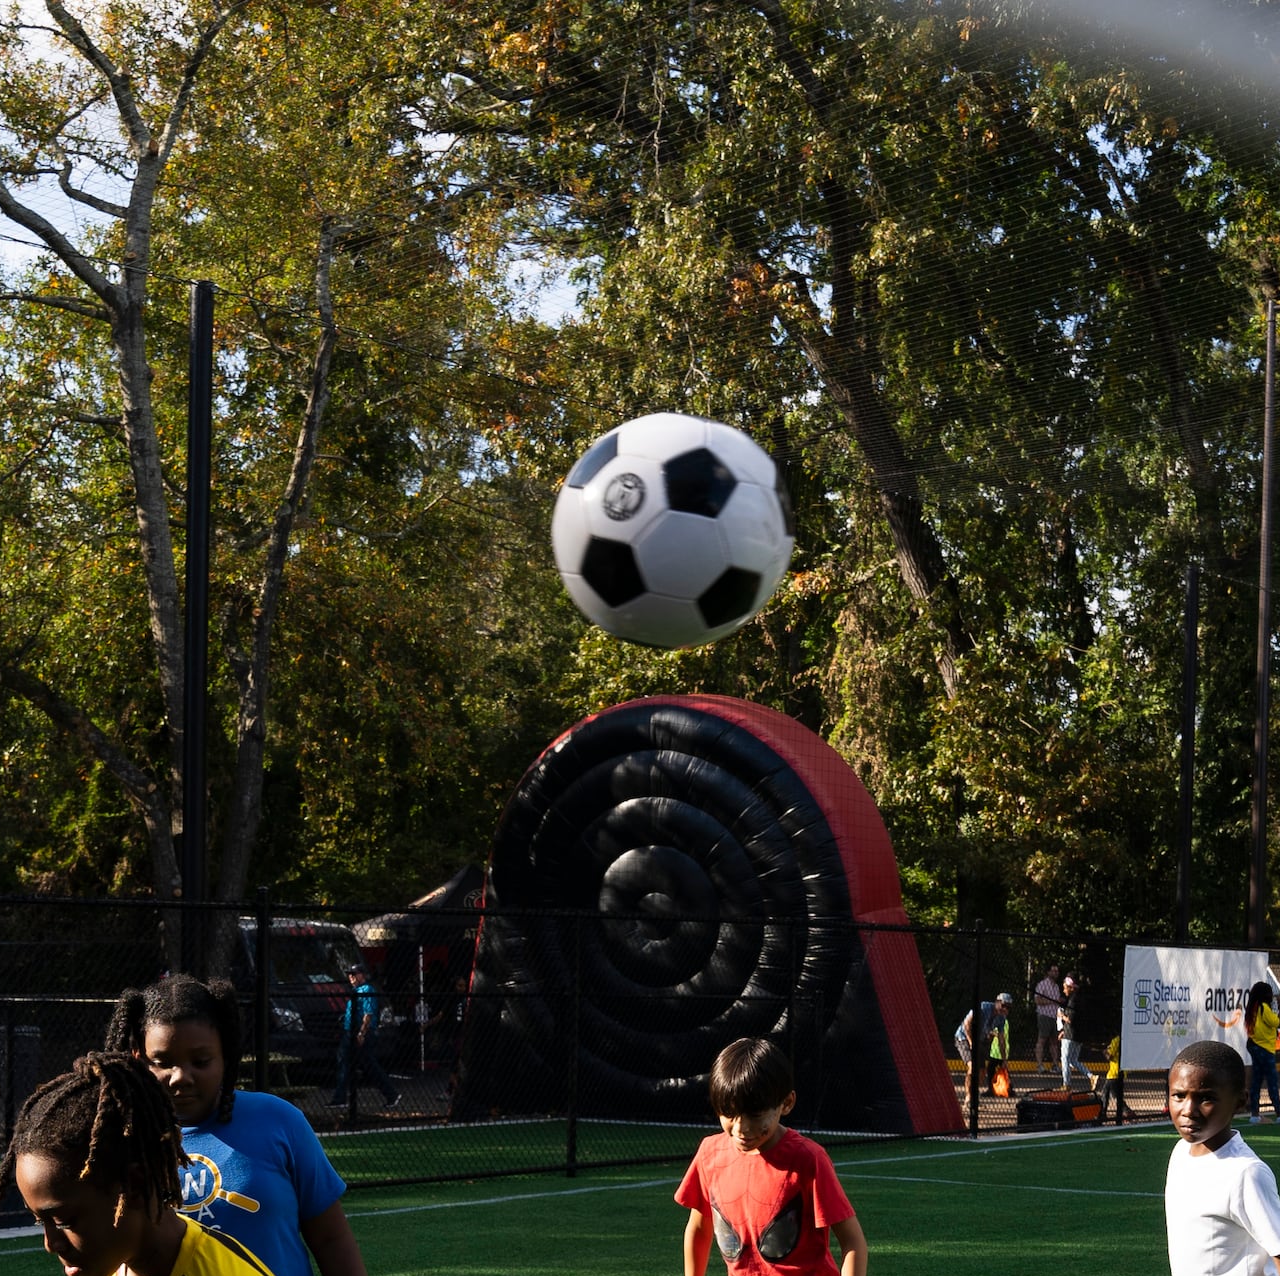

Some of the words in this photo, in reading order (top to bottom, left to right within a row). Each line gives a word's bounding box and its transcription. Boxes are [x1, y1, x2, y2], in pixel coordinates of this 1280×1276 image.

[1153, 978, 1191, 1002] Station
[1205, 987, 1251, 1012] amazo
[1152, 1003, 1190, 1025] Soccer
